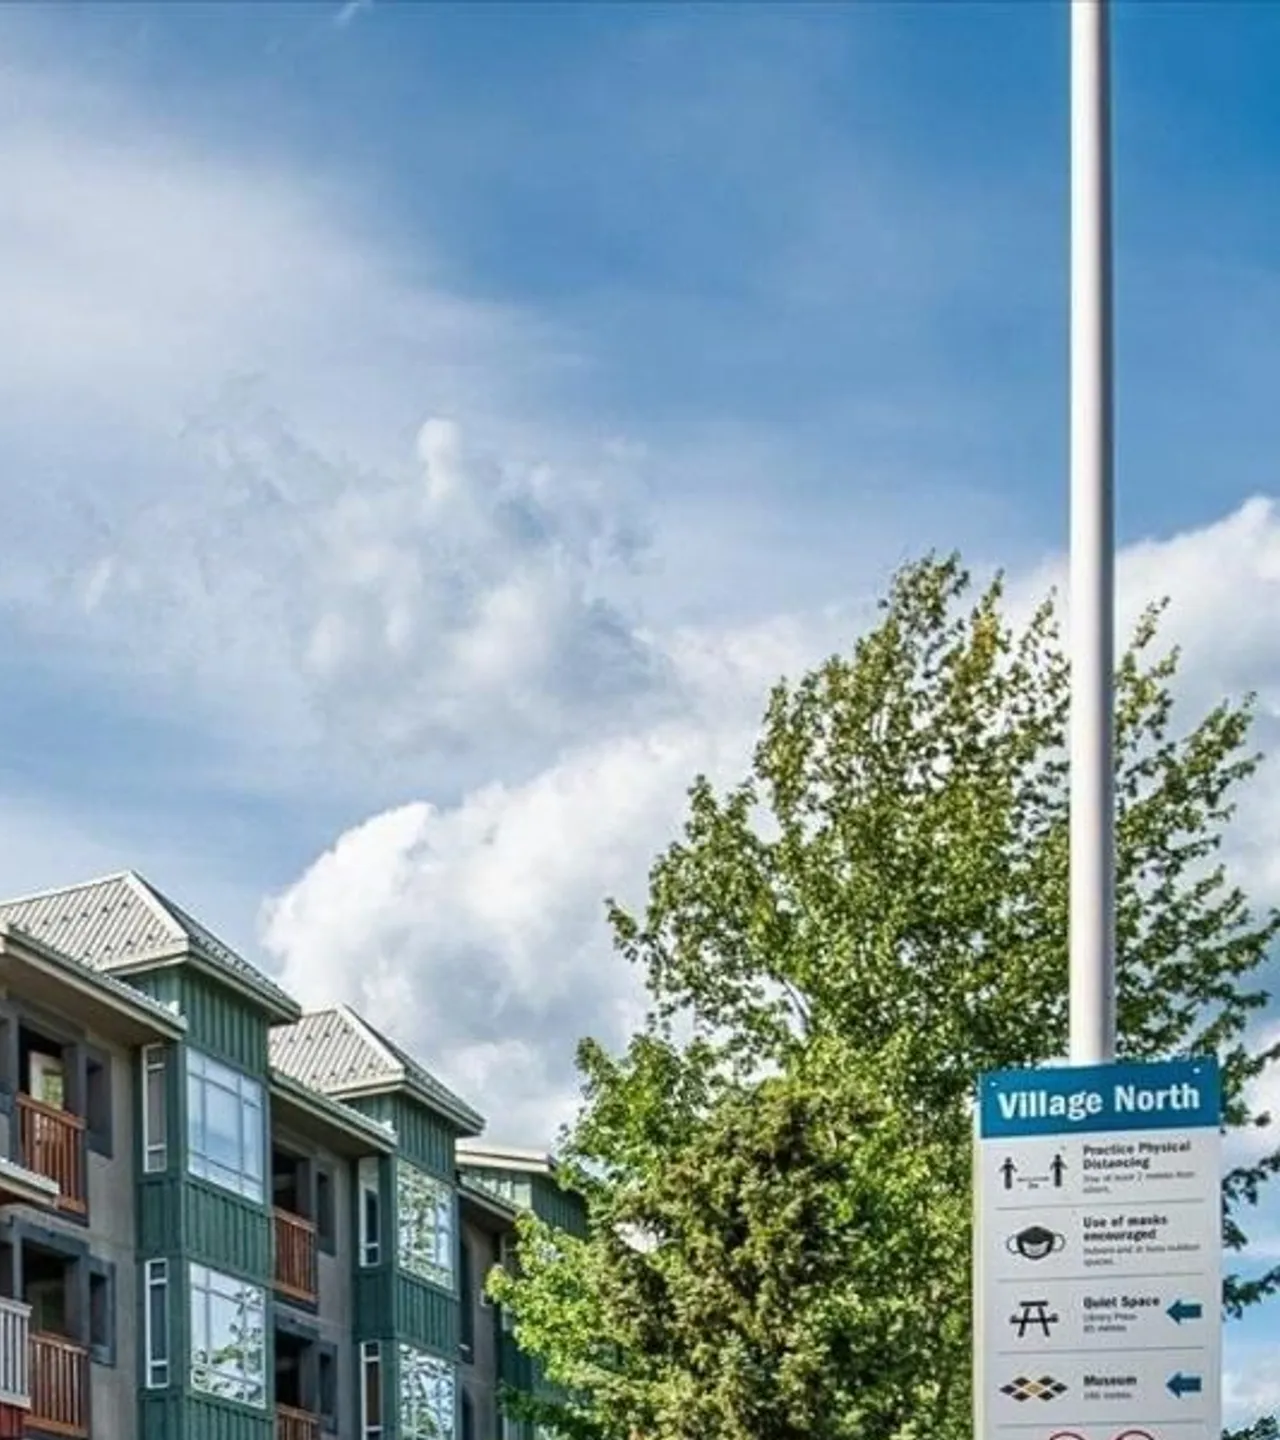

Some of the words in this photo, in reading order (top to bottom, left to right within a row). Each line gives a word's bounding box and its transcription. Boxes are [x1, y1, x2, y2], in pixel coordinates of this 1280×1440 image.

[998, 1090, 1103, 1121] Village
[1114, 1083, 1201, 1113] North
[1082, 1144, 1135, 1157] Practice
[1138, 1140, 1192, 1155] Physical
[1082, 1155, 1151, 1171] Distancing
[1083, 1216, 1106, 1229] Use
[1111, 1215, 1124, 1227] of
[1127, 1214, 1168, 1226] masks
[1083, 1229, 1157, 1242] encouraged
[1083, 1296, 1118, 1310] Quiet
[1120, 1295, 1161, 1309] Space
[1083, 1375, 1138, 1387] Museum
